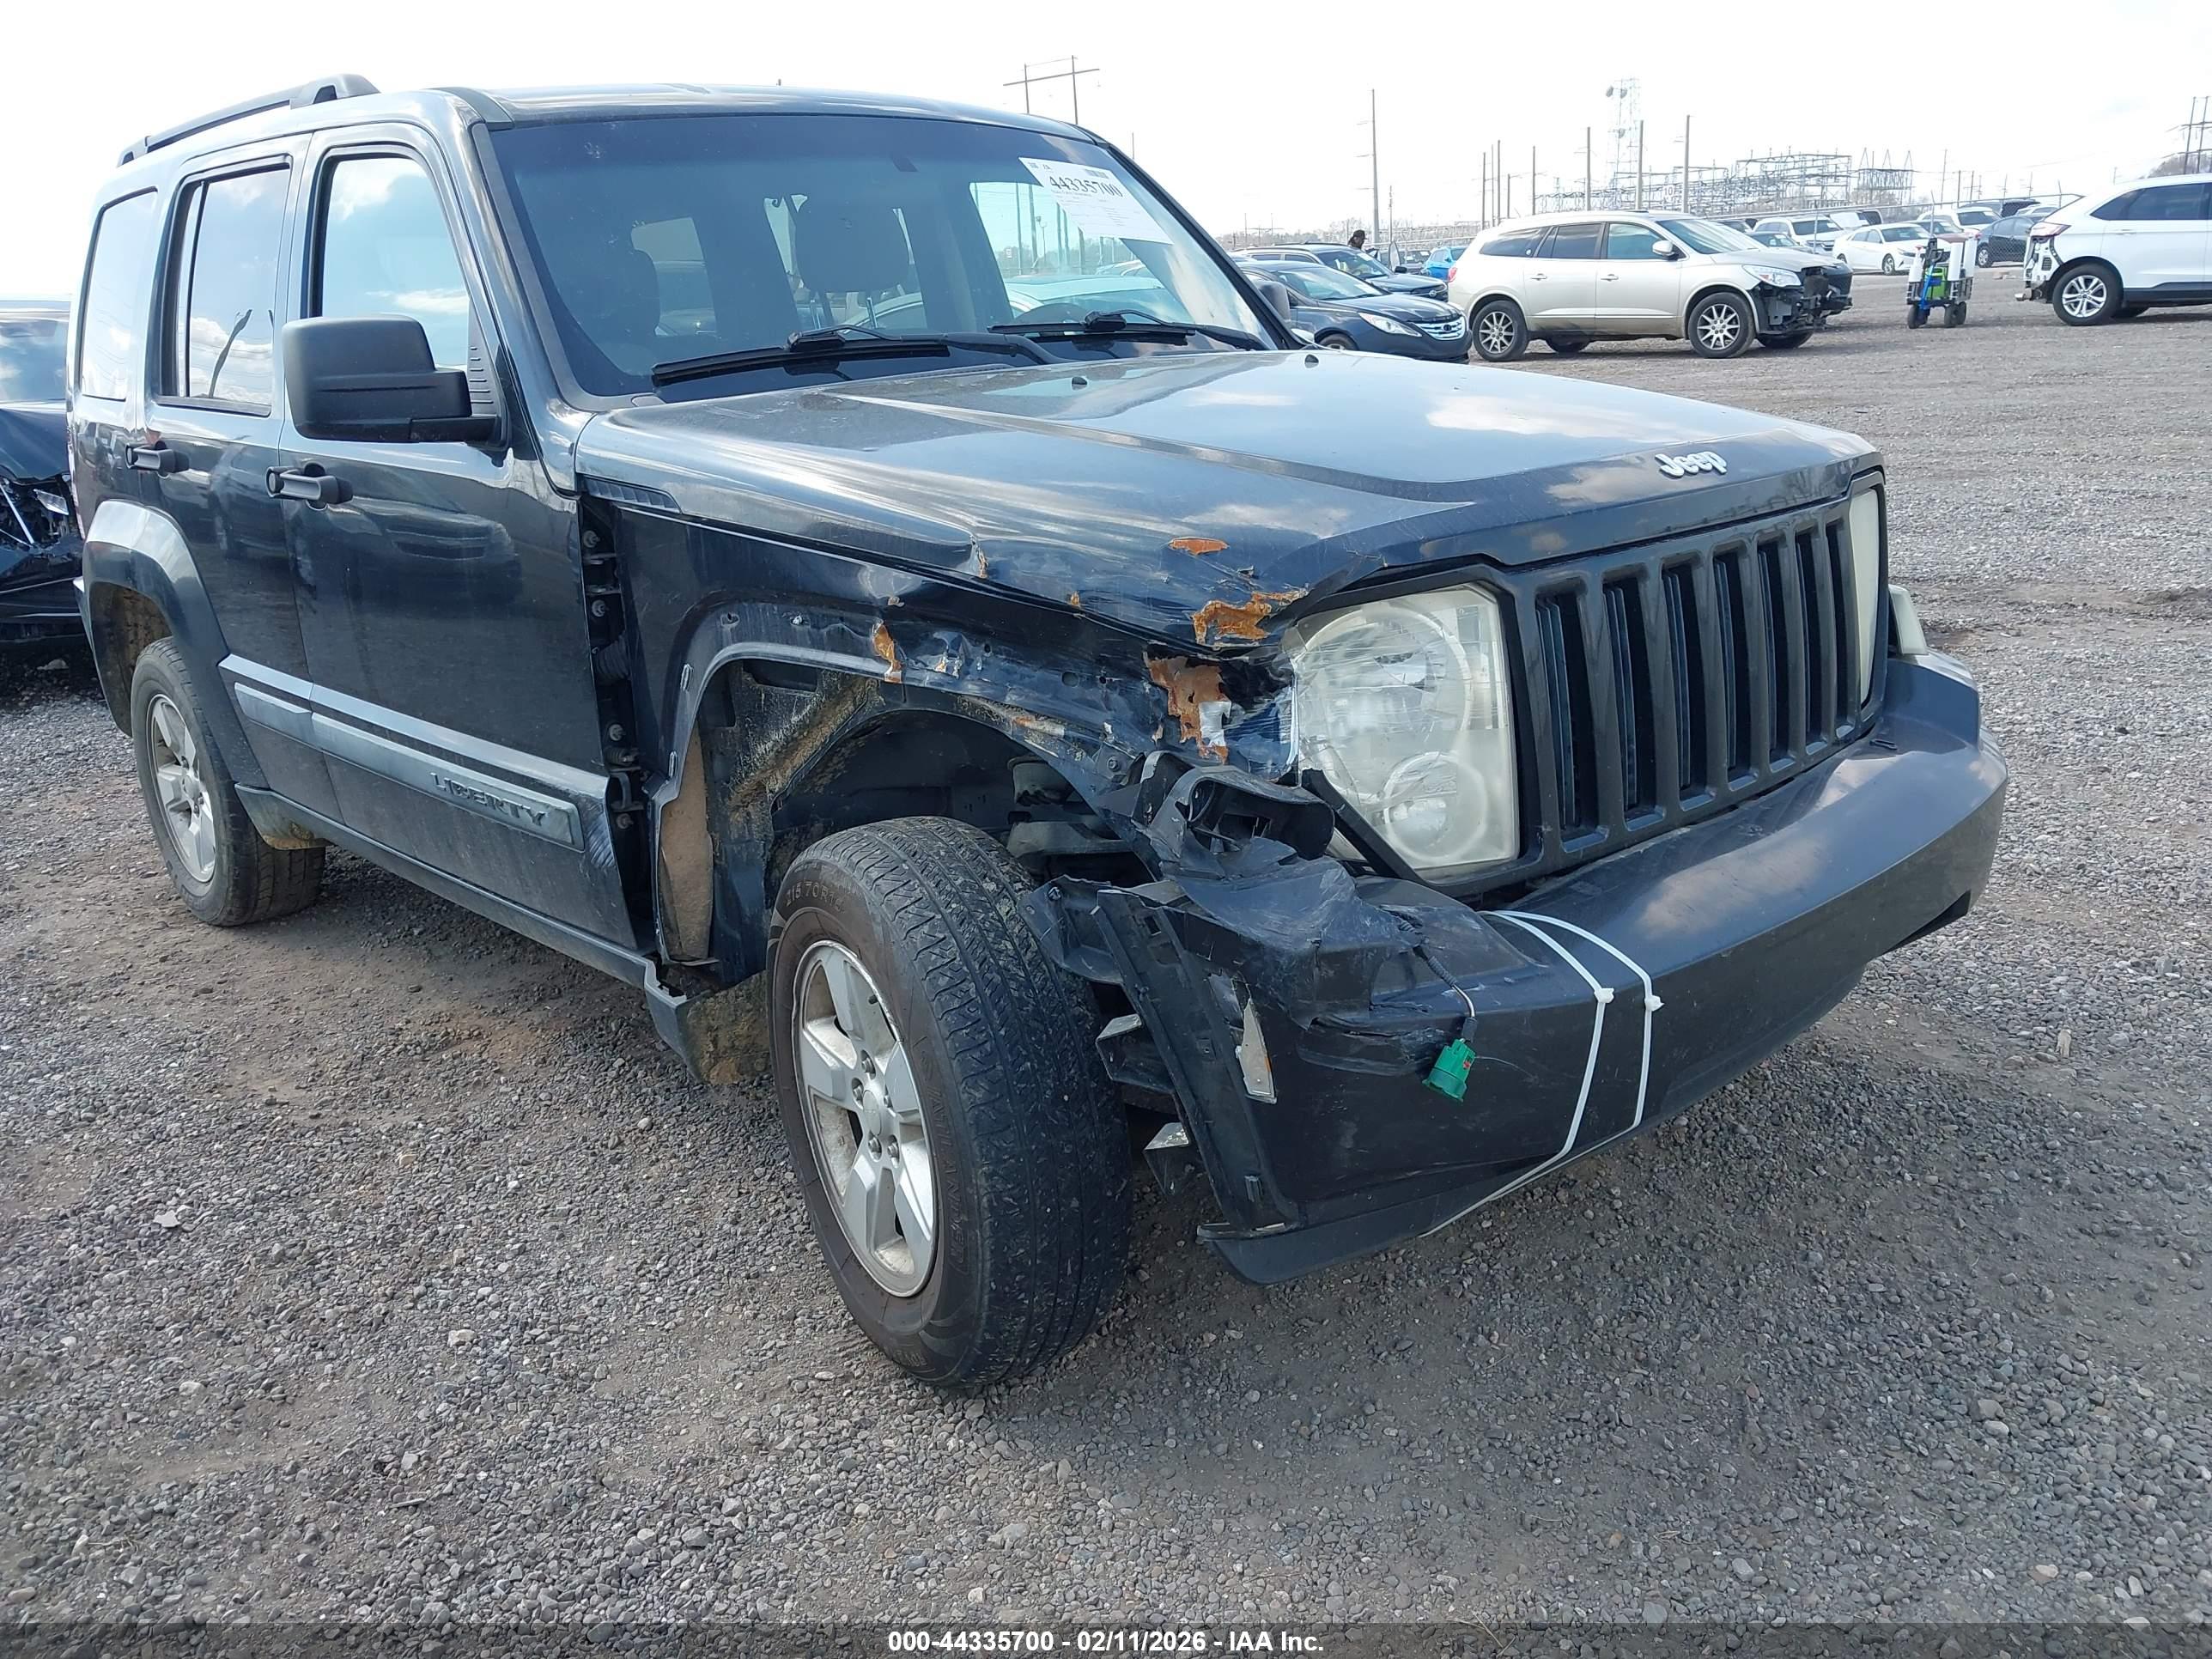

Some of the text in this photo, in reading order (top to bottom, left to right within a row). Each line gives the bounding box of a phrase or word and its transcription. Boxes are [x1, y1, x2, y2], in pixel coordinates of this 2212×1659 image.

[1050, 177, 1123, 197] 44335700
[1655, 452, 1728, 477] Jeep
[429, 772, 549, 826] LIBERTY
